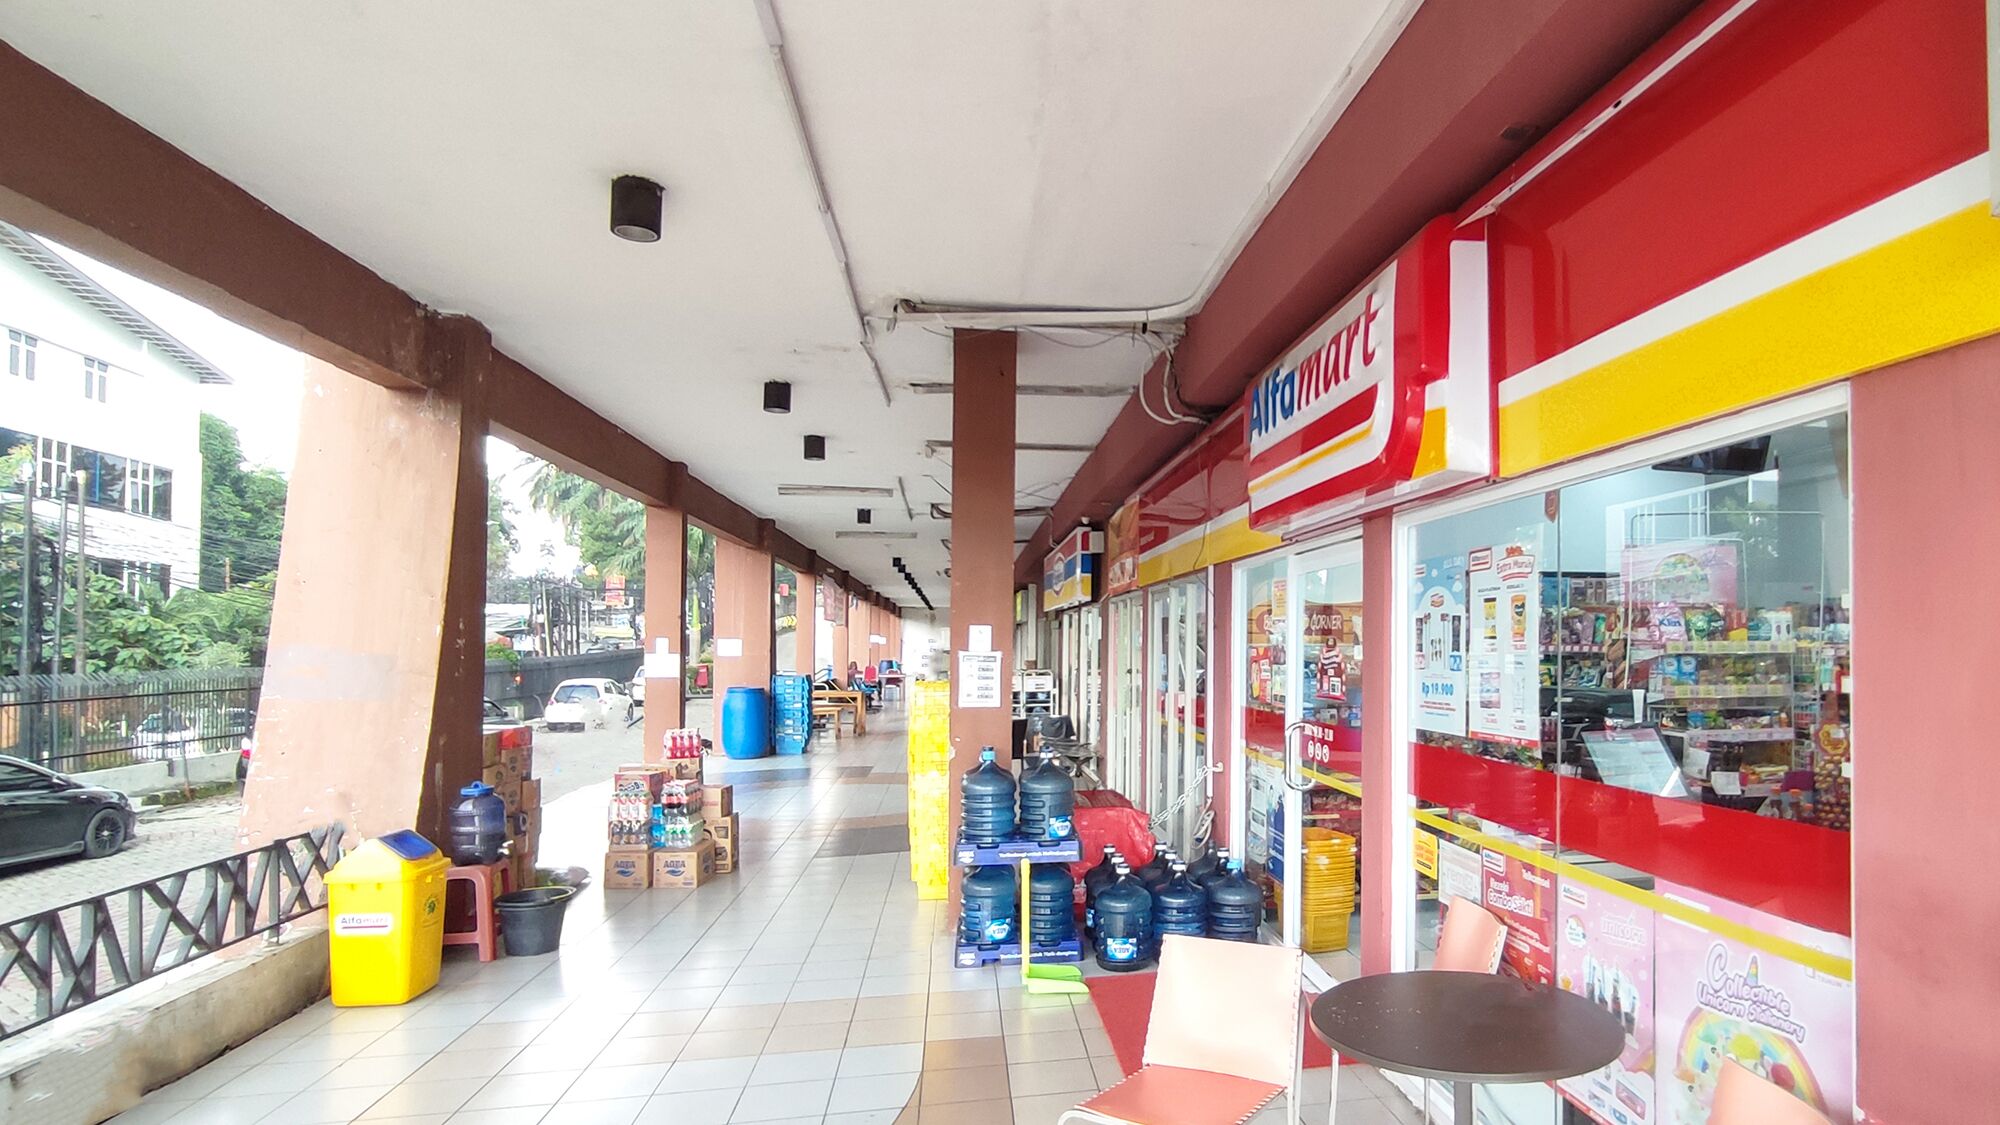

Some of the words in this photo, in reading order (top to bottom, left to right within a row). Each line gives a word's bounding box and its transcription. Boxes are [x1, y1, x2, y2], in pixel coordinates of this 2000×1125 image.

[1249, 293, 1380, 443] Alfamart
[1311, 614, 1342, 631] CORNER
[1422, 682, 1430, 697] Rp
[1706, 943, 1791, 1018] Collectible
[1697, 981, 1746, 1018] Unicorn
[1747, 1001, 1806, 1044] Stationery
